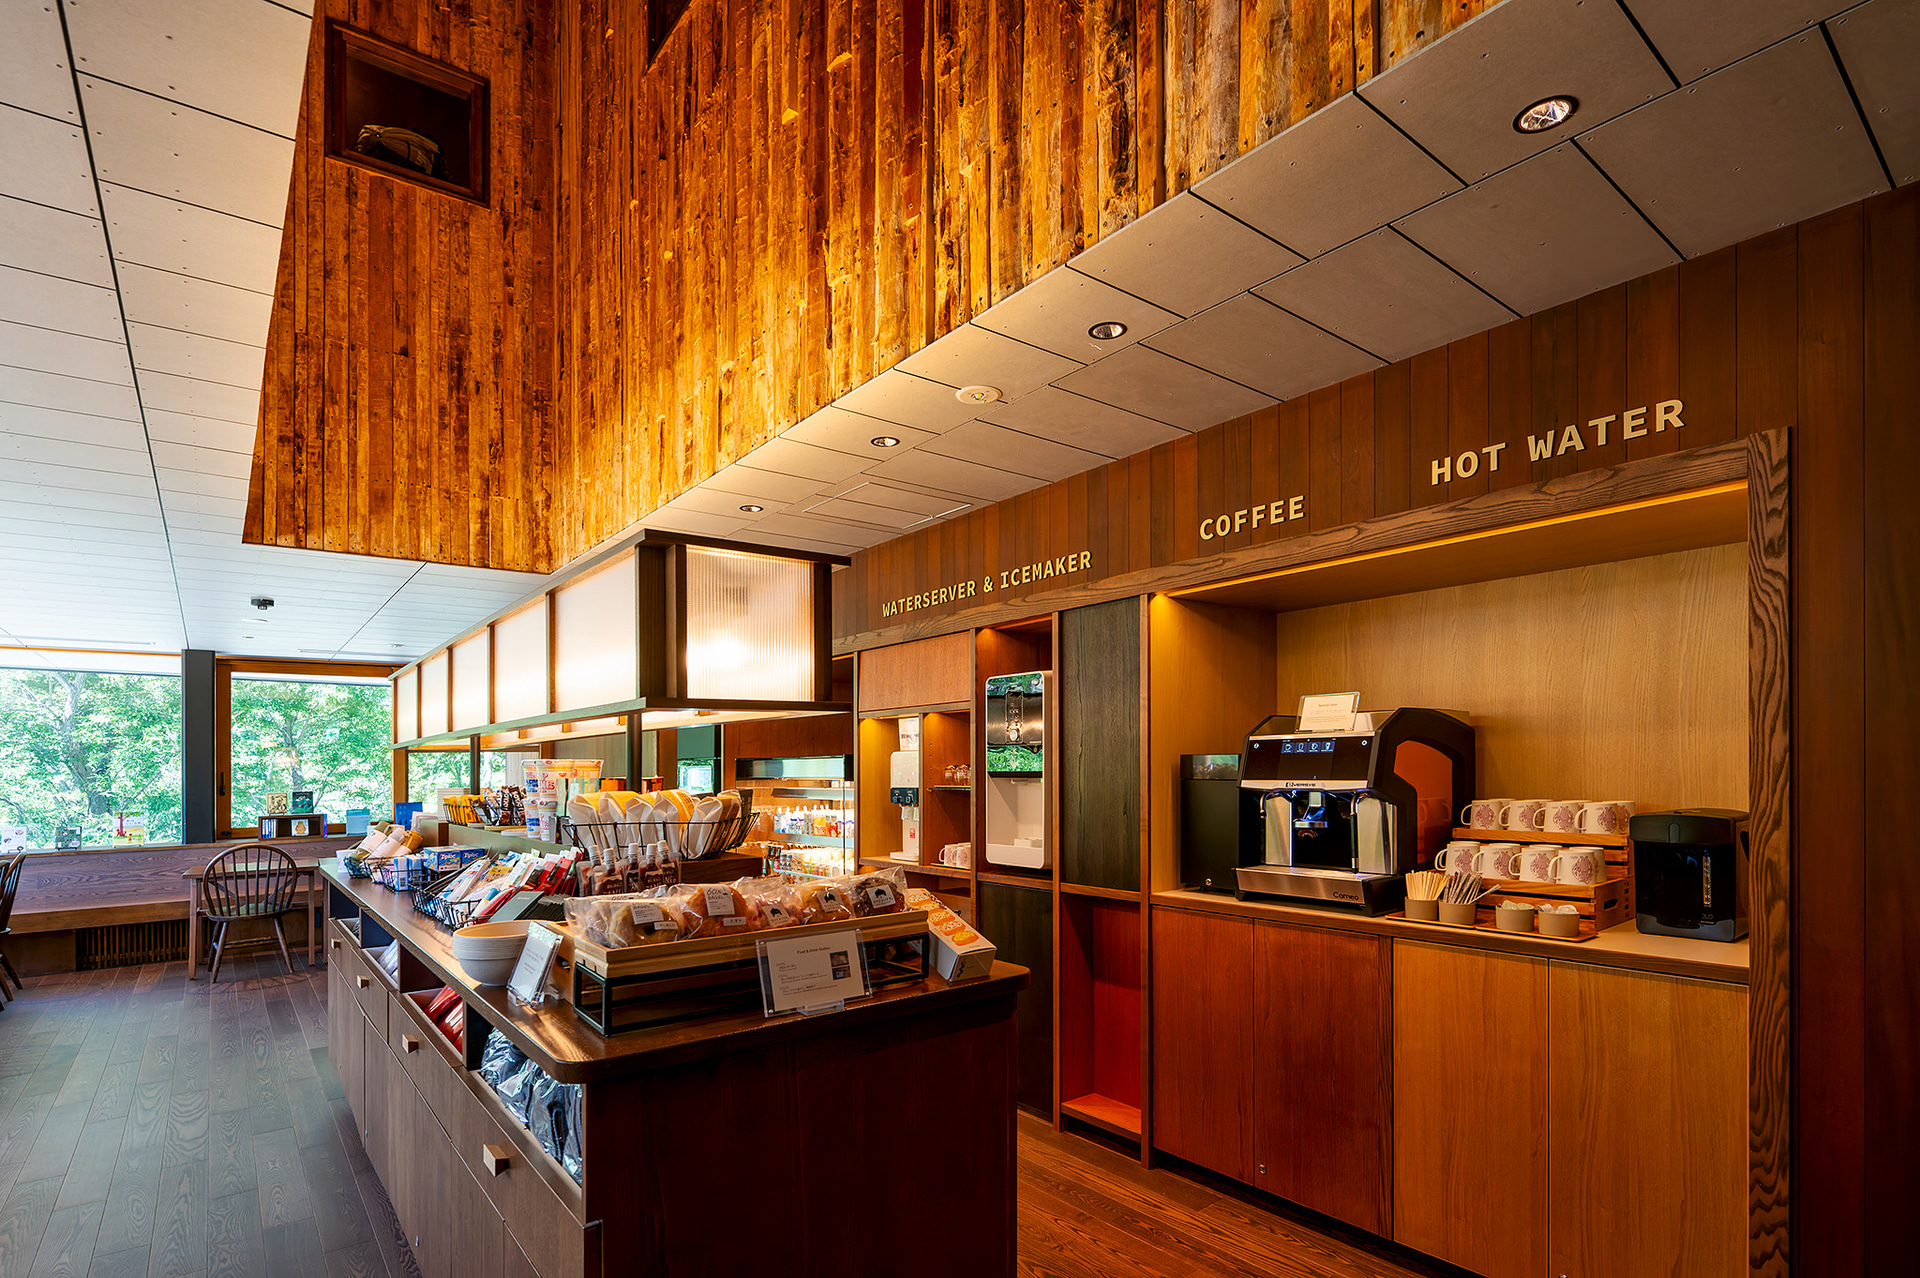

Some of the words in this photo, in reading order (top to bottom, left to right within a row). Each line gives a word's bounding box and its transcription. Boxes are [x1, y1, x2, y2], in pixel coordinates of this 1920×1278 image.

[1430, 442, 1507, 486] HOT
[1527, 399, 1686, 462] WATER
[1198, 494, 1307, 541] COFFEE
[882, 580, 976, 618] WATERSERVER
[983, 575, 994, 592] &
[1000, 550, 1093, 589] ICEMAKER
[1333, 891, 1359, 901] Cameo
